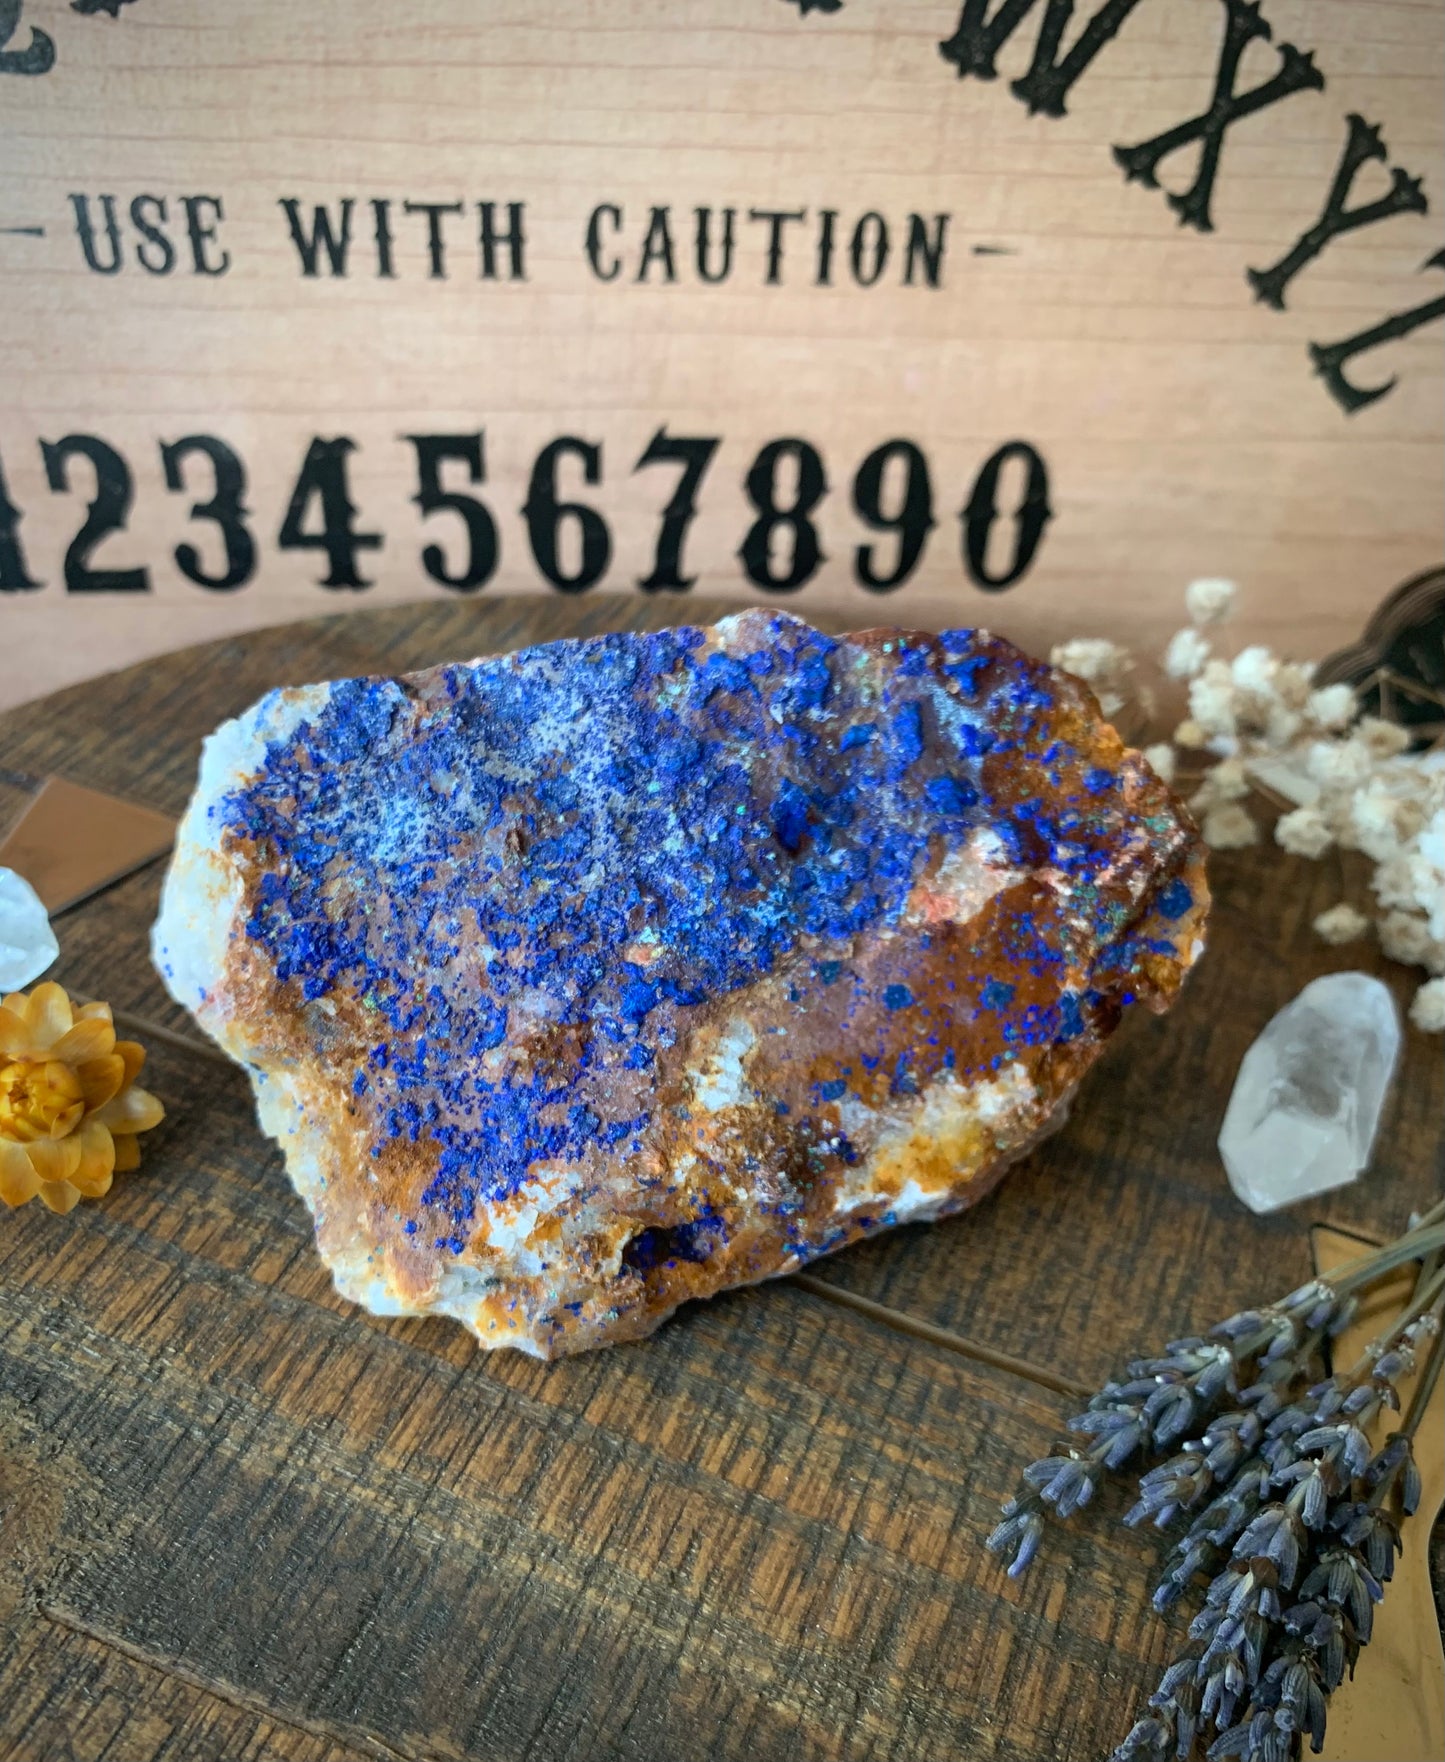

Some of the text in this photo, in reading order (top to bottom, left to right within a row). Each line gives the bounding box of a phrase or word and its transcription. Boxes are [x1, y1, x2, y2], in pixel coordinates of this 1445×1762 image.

[67, 192, 951, 290] USE WITH CAUTION
